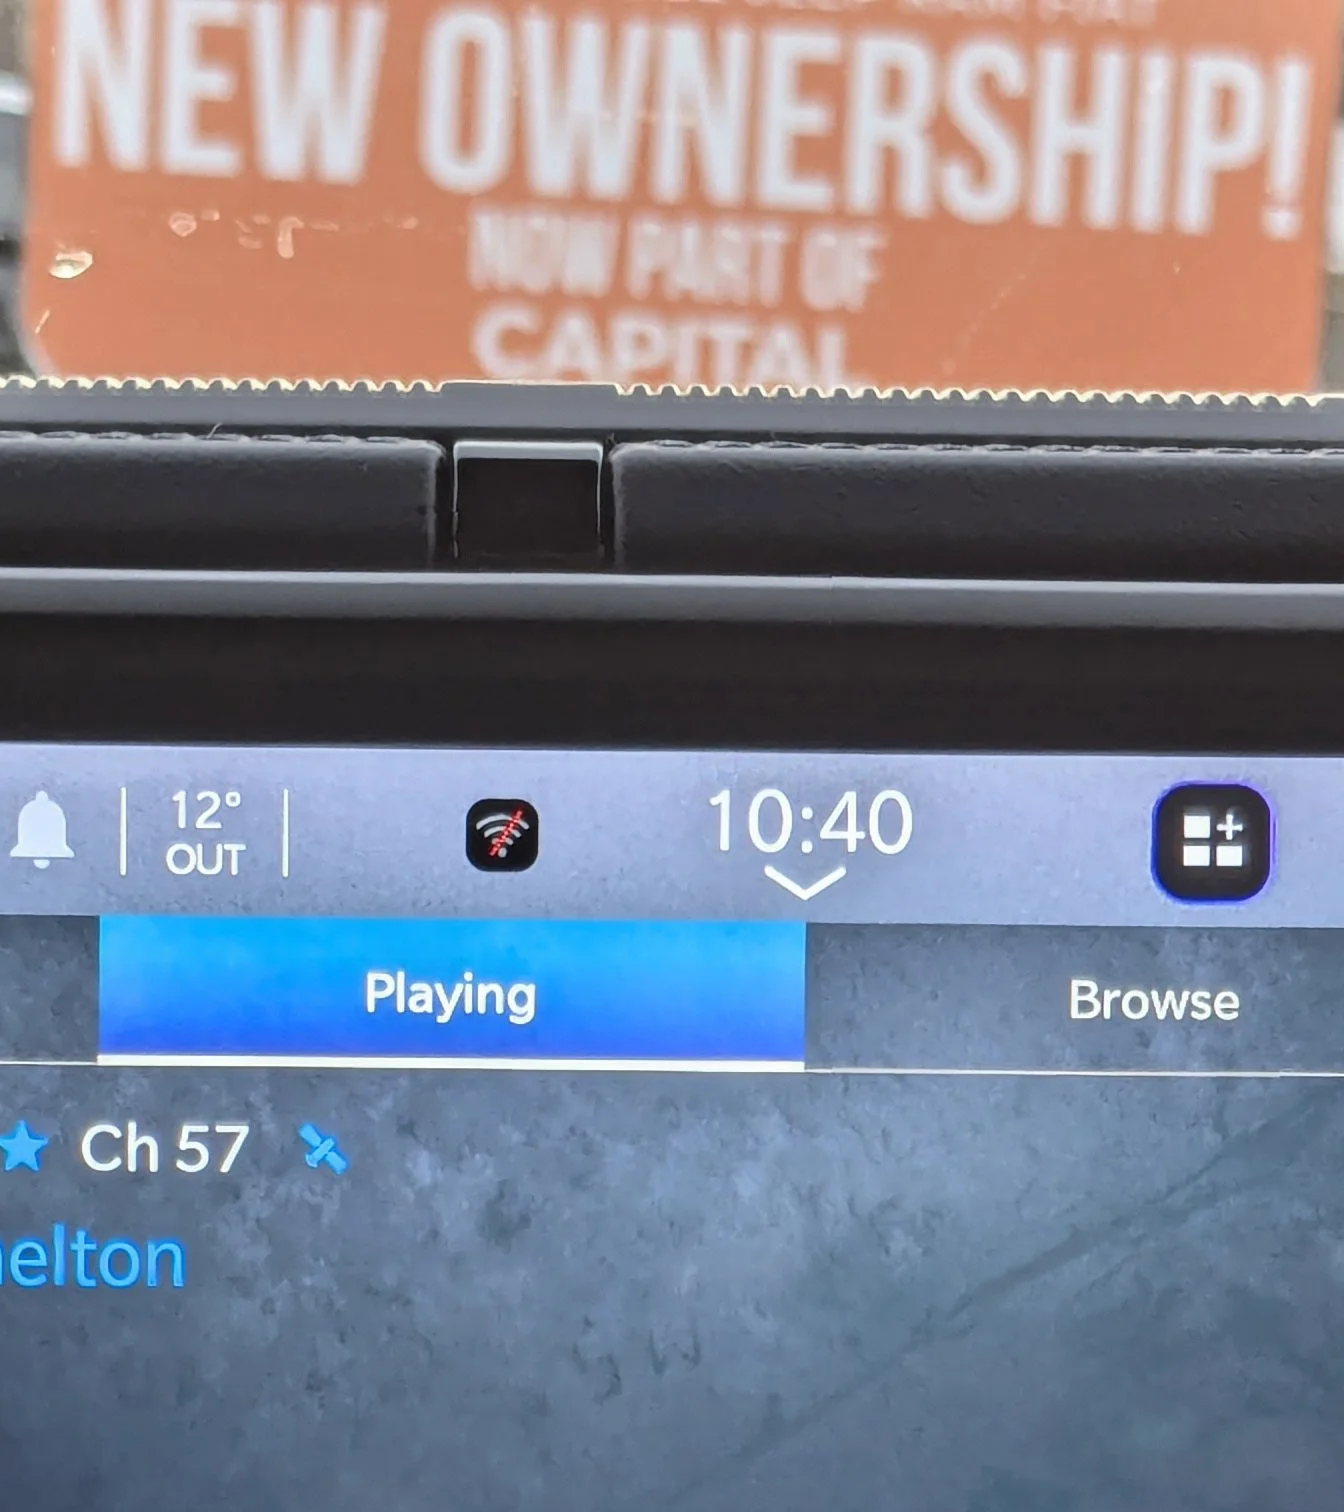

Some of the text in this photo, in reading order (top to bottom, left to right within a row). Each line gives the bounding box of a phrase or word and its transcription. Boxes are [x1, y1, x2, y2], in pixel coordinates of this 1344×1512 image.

[52, 0, 1314, 242] NEW OWNERSHIP!
[468, 210, 890, 312] NOW PART OF
[470, 306, 862, 388] CAPITAL
[172, 790, 241, 830] 12°
[709, 787, 914, 855] 10:40
[165, 843, 246, 875] OUT
[365, 971, 537, 1024] Playing
[1070, 980, 1241, 1021] Browse
[80, 1124, 250, 1173] Ch 57
